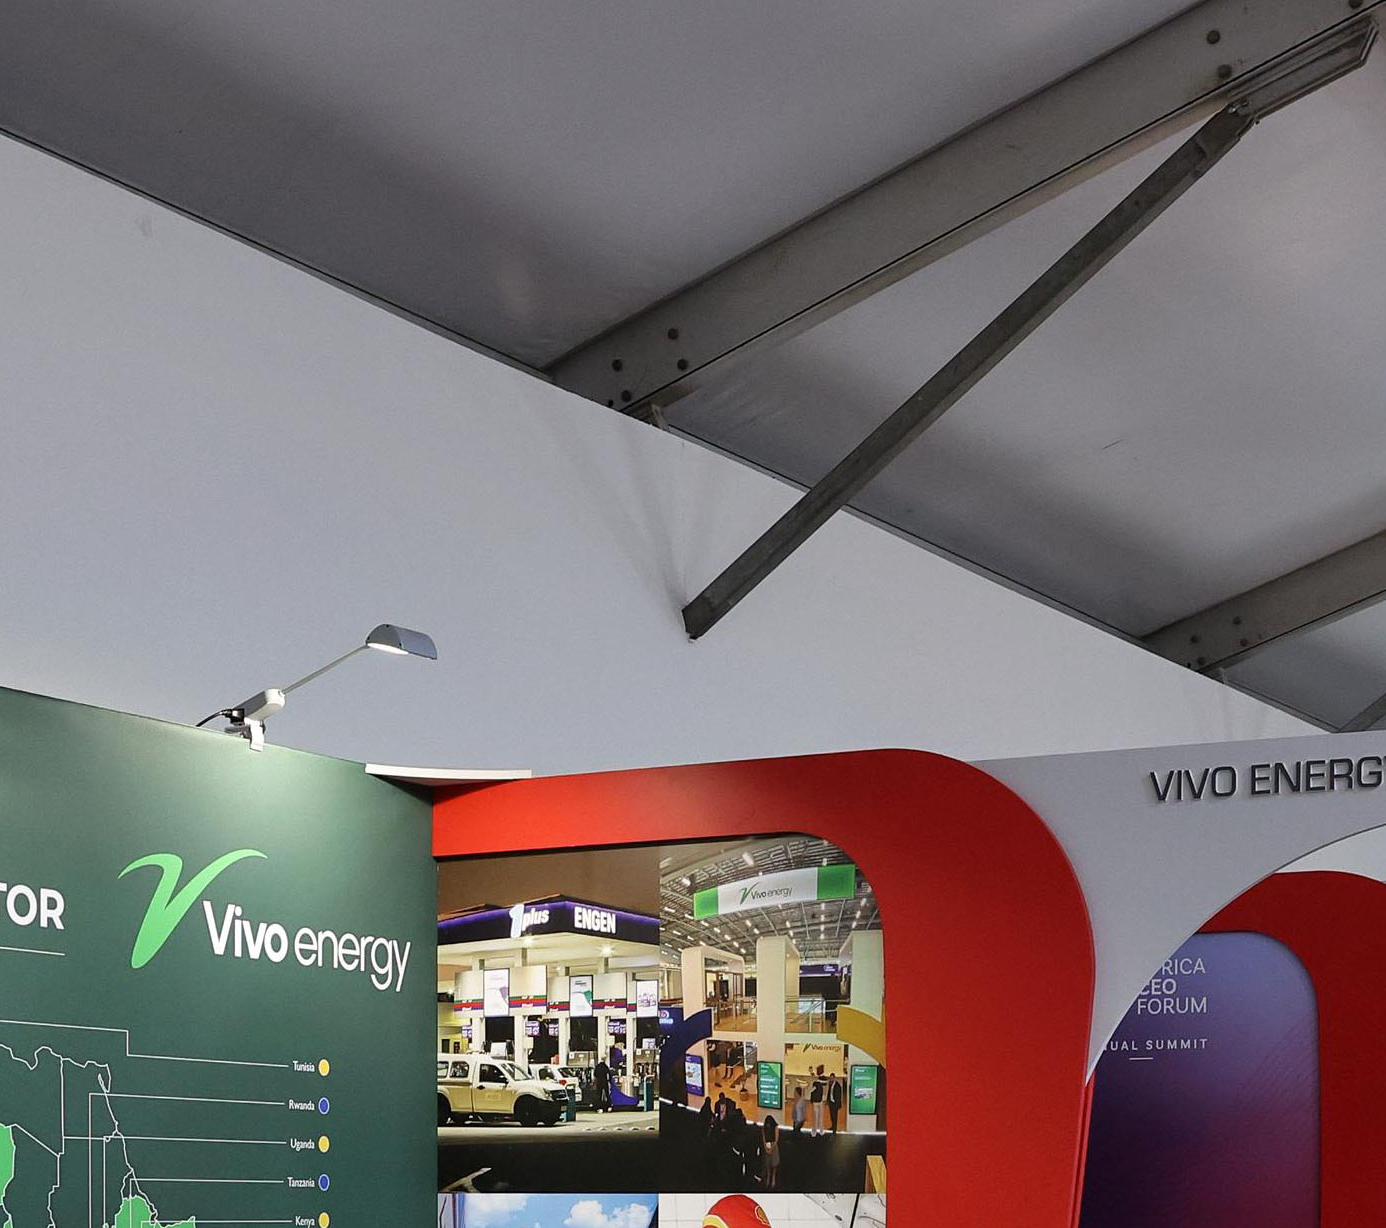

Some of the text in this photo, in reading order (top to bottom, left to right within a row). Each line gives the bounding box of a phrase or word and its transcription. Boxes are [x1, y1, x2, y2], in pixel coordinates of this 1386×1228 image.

[1149, 765, 1237, 801] VIVO
[574, 906, 617, 934] ENGEN
[201, 899, 411, 992] Vivo energy
[1137, 996, 1207, 1015] FORUM
[1104, 1038, 1208, 1051] UAL SUMMIT
[293, 1060, 315, 1072] Tunisia
[288, 1099, 315, 1111] Rwanda
[290, 1138, 315, 1151] Uganda
[287, 1176, 315, 1188] Tanzania
[295, 1215, 315, 1228] Kenya
